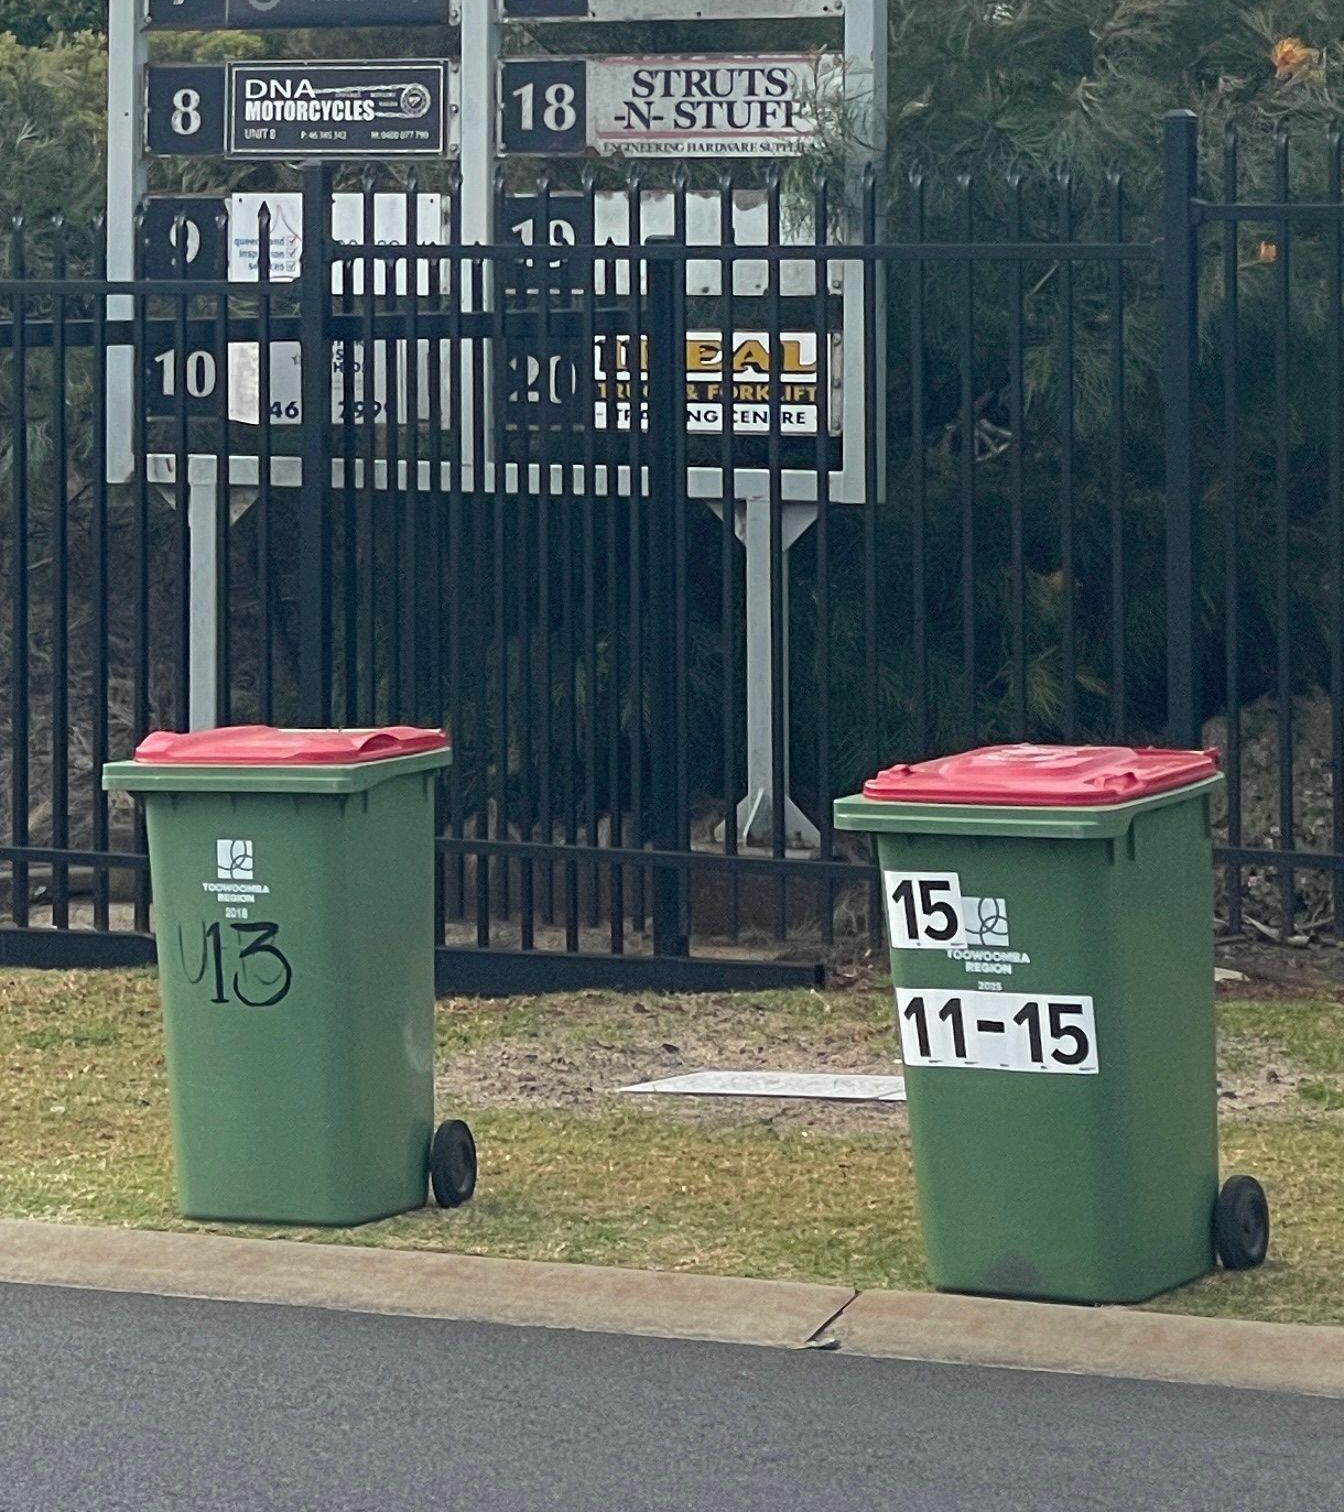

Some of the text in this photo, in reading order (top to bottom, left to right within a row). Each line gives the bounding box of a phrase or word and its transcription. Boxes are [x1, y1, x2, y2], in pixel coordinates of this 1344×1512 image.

[170, 79, 316, 135] 8 DNA
[245, 99, 376, 122] MOTORCYCLES
[512, 67, 788, 131] 18 STRUTS
[244, 128, 268, 140] UNIT
[603, 142, 685, 153] ENGINEERING
[687, 142, 757, 153] HARDWARE
[154, 349, 217, 398] 10
[892, 879, 959, 941] 15
[965, 962, 1012, 975] REGION
[903, 996, 1089, 1066] 11-15
